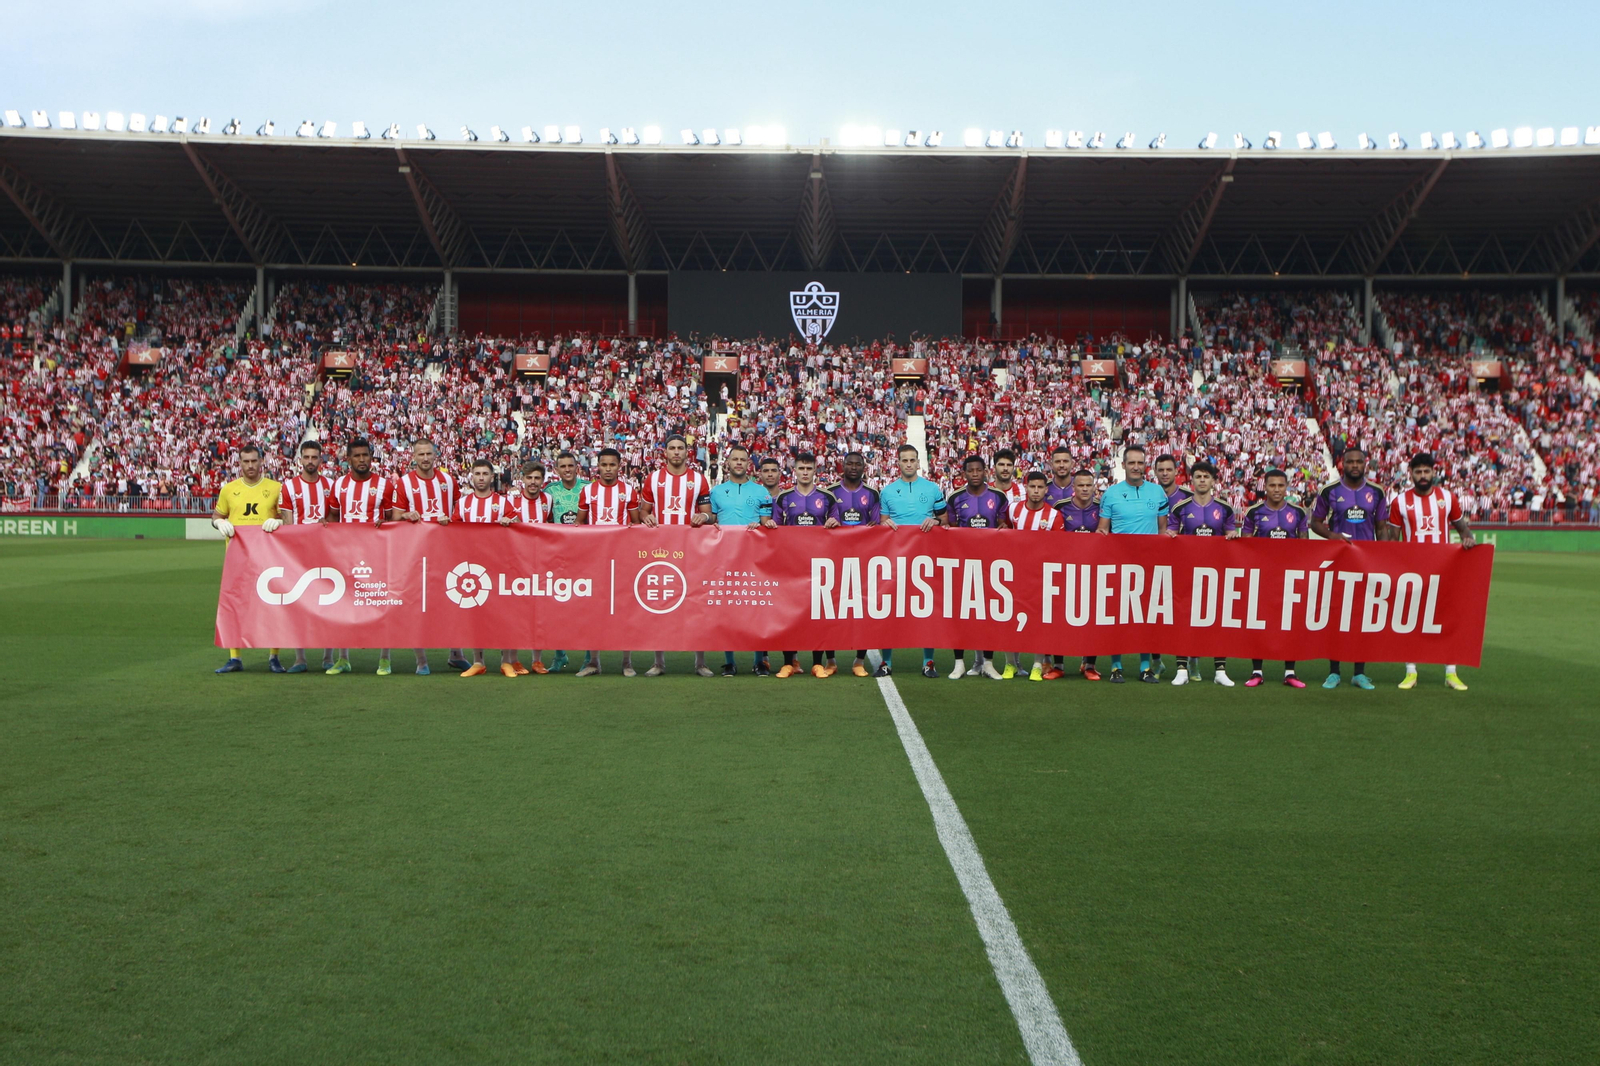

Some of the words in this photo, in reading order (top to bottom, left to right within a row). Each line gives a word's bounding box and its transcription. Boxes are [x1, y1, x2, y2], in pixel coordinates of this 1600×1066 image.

[796, 296, 806, 304] U
[822, 296, 833, 304] D
[0, 520, 57, 535] REEN
[63, 520, 77, 535] H
[673, 551, 684, 559] 09
[354, 581, 387, 589] Consejo
[498, 571, 592, 602] LaLiga
[354, 589, 388, 598] Superior
[811, 555, 1027, 631] RACISTAS,
[1043, 563, 1174, 627] FUERA
[1191, 567, 1267, 630] DEL
[1281, 561, 1442, 634] FÚTBOL
[366, 599, 403, 607] Deportes
